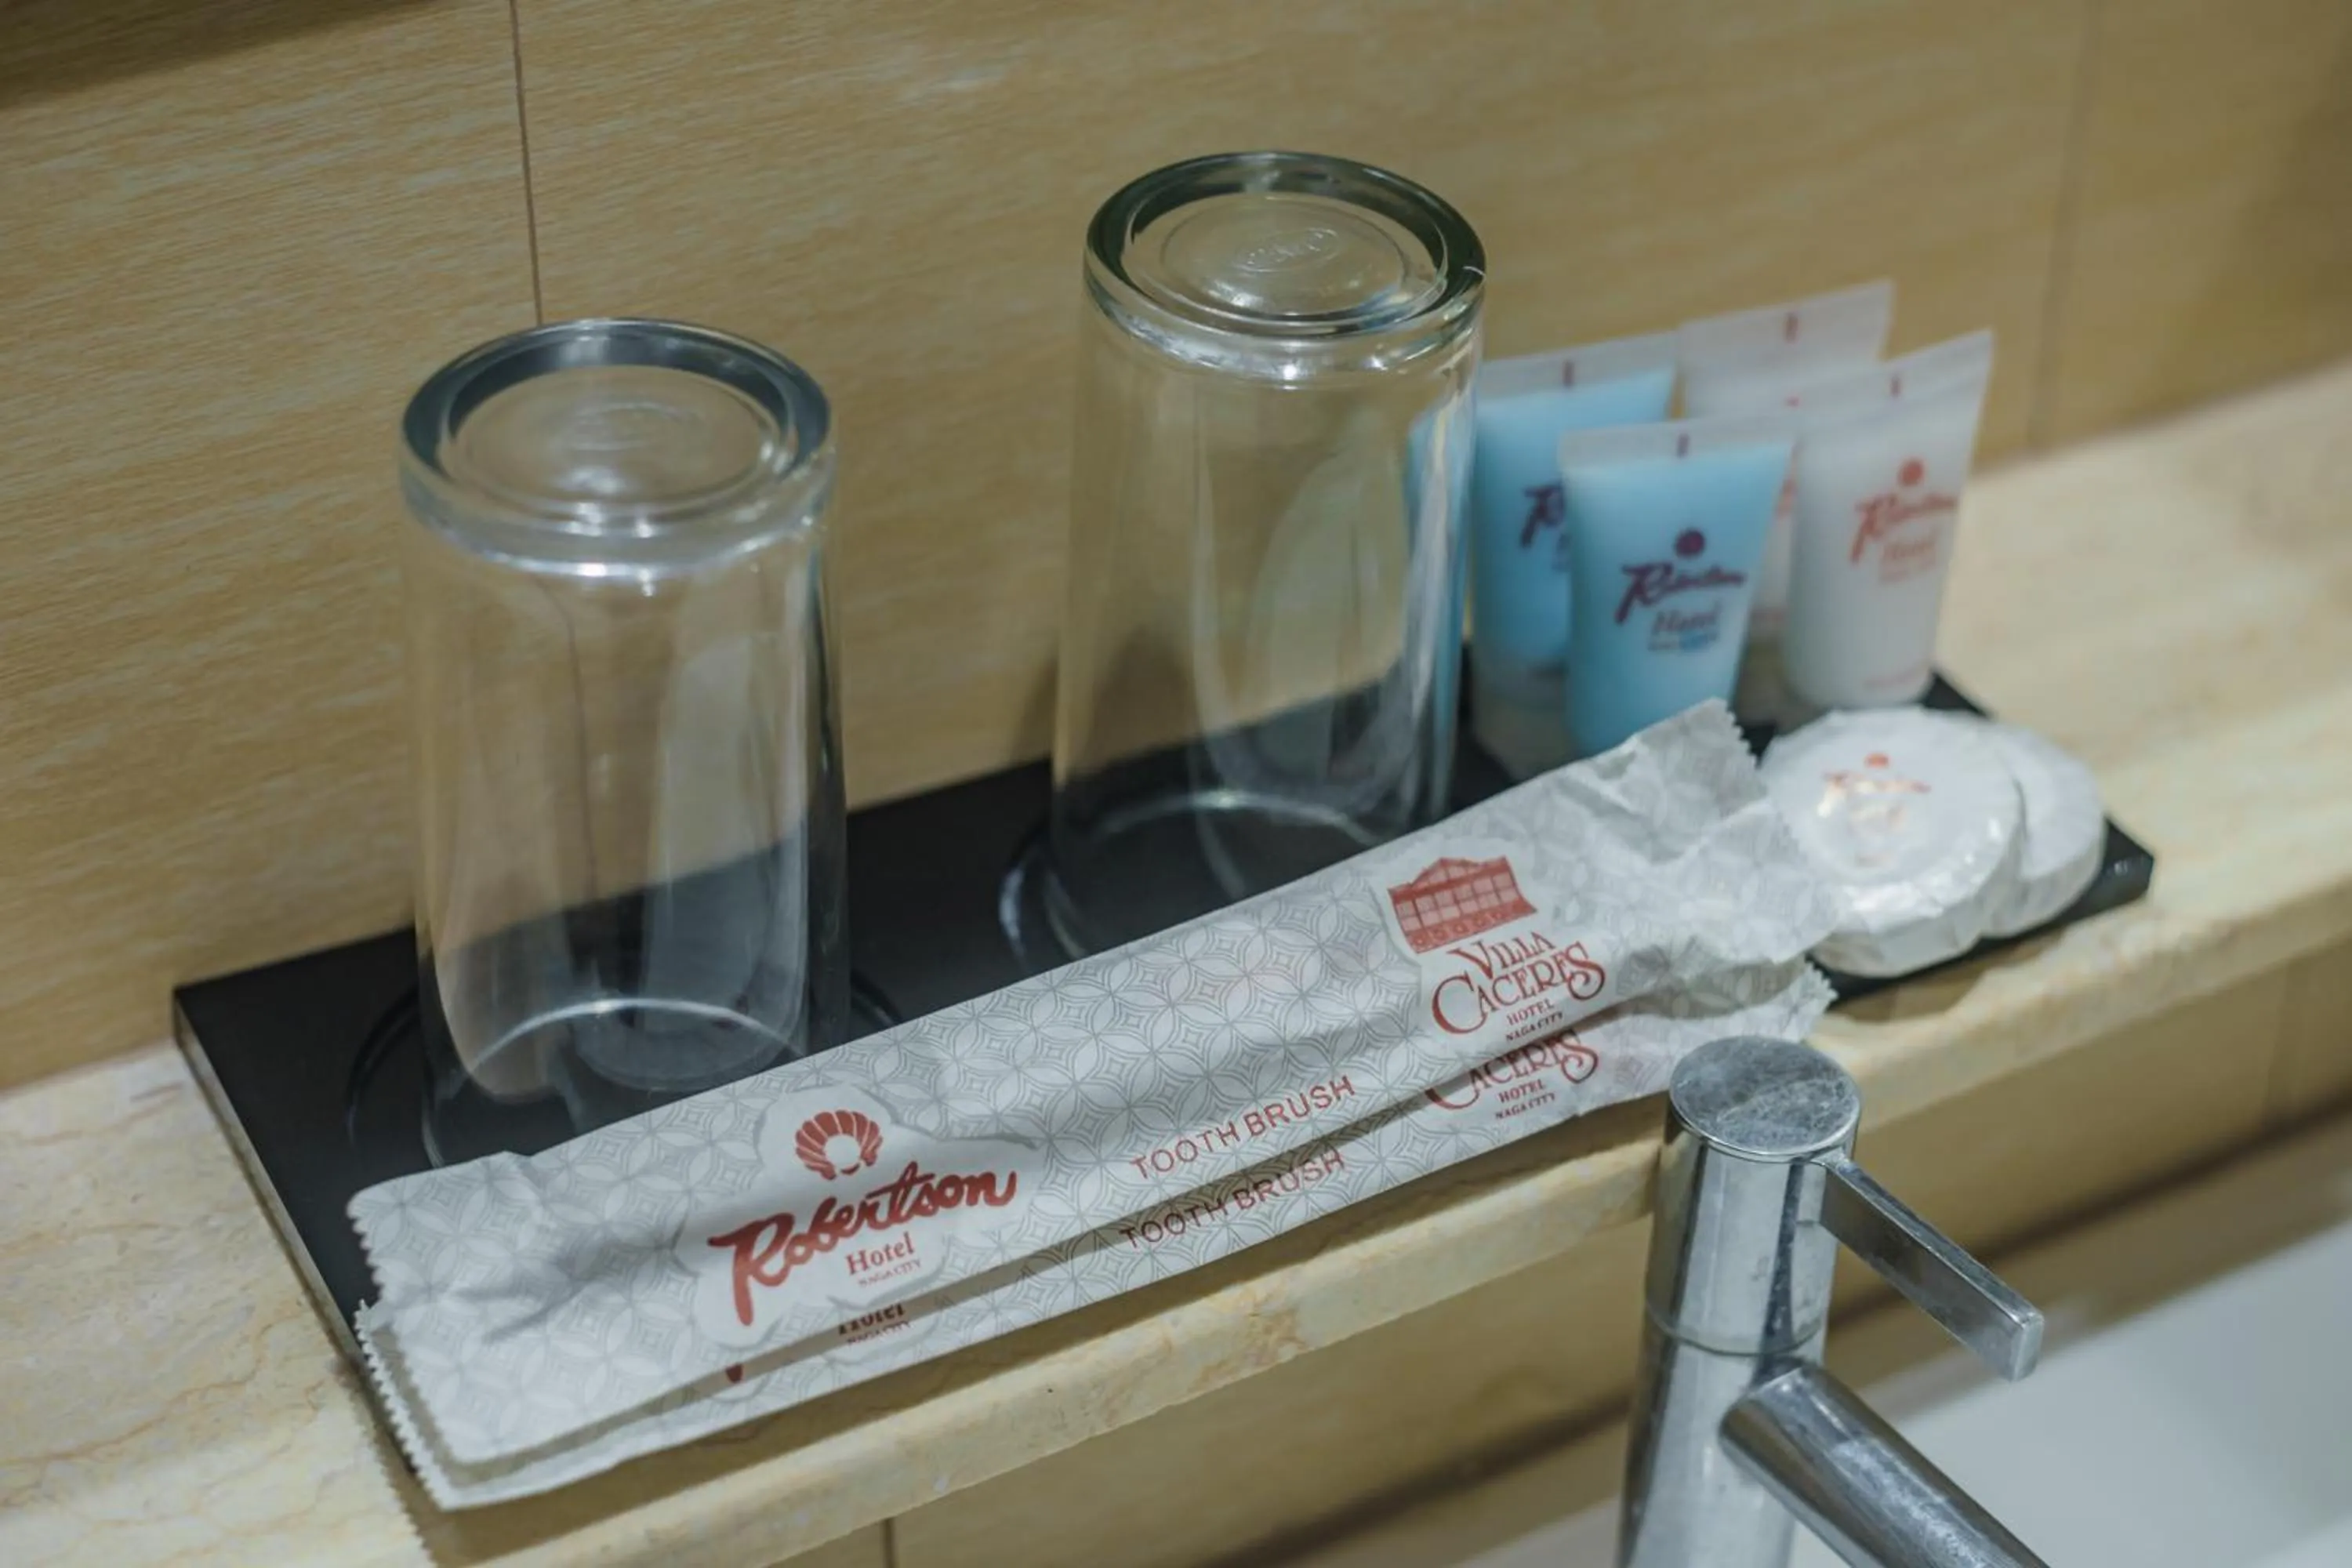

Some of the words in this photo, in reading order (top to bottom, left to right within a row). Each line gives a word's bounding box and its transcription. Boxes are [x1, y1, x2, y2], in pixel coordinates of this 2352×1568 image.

[1432, 941, 1606, 1034] CACERES
[1446, 931, 1556, 979] VILLA
[1506, 998, 1555, 1025] HOTEL
[1499, 1079, 1546, 1104] HOTEL
[1131, 1121, 1241, 1180] TOOTH
[1243, 1075, 1356, 1138] BRUSH
[1119, 1198, 1228, 1248] TOOTH
[1232, 1146, 1345, 1210] BRUSH
[708, 1161, 1018, 1327] Robertson
[844, 1231, 915, 1276] Hotel
